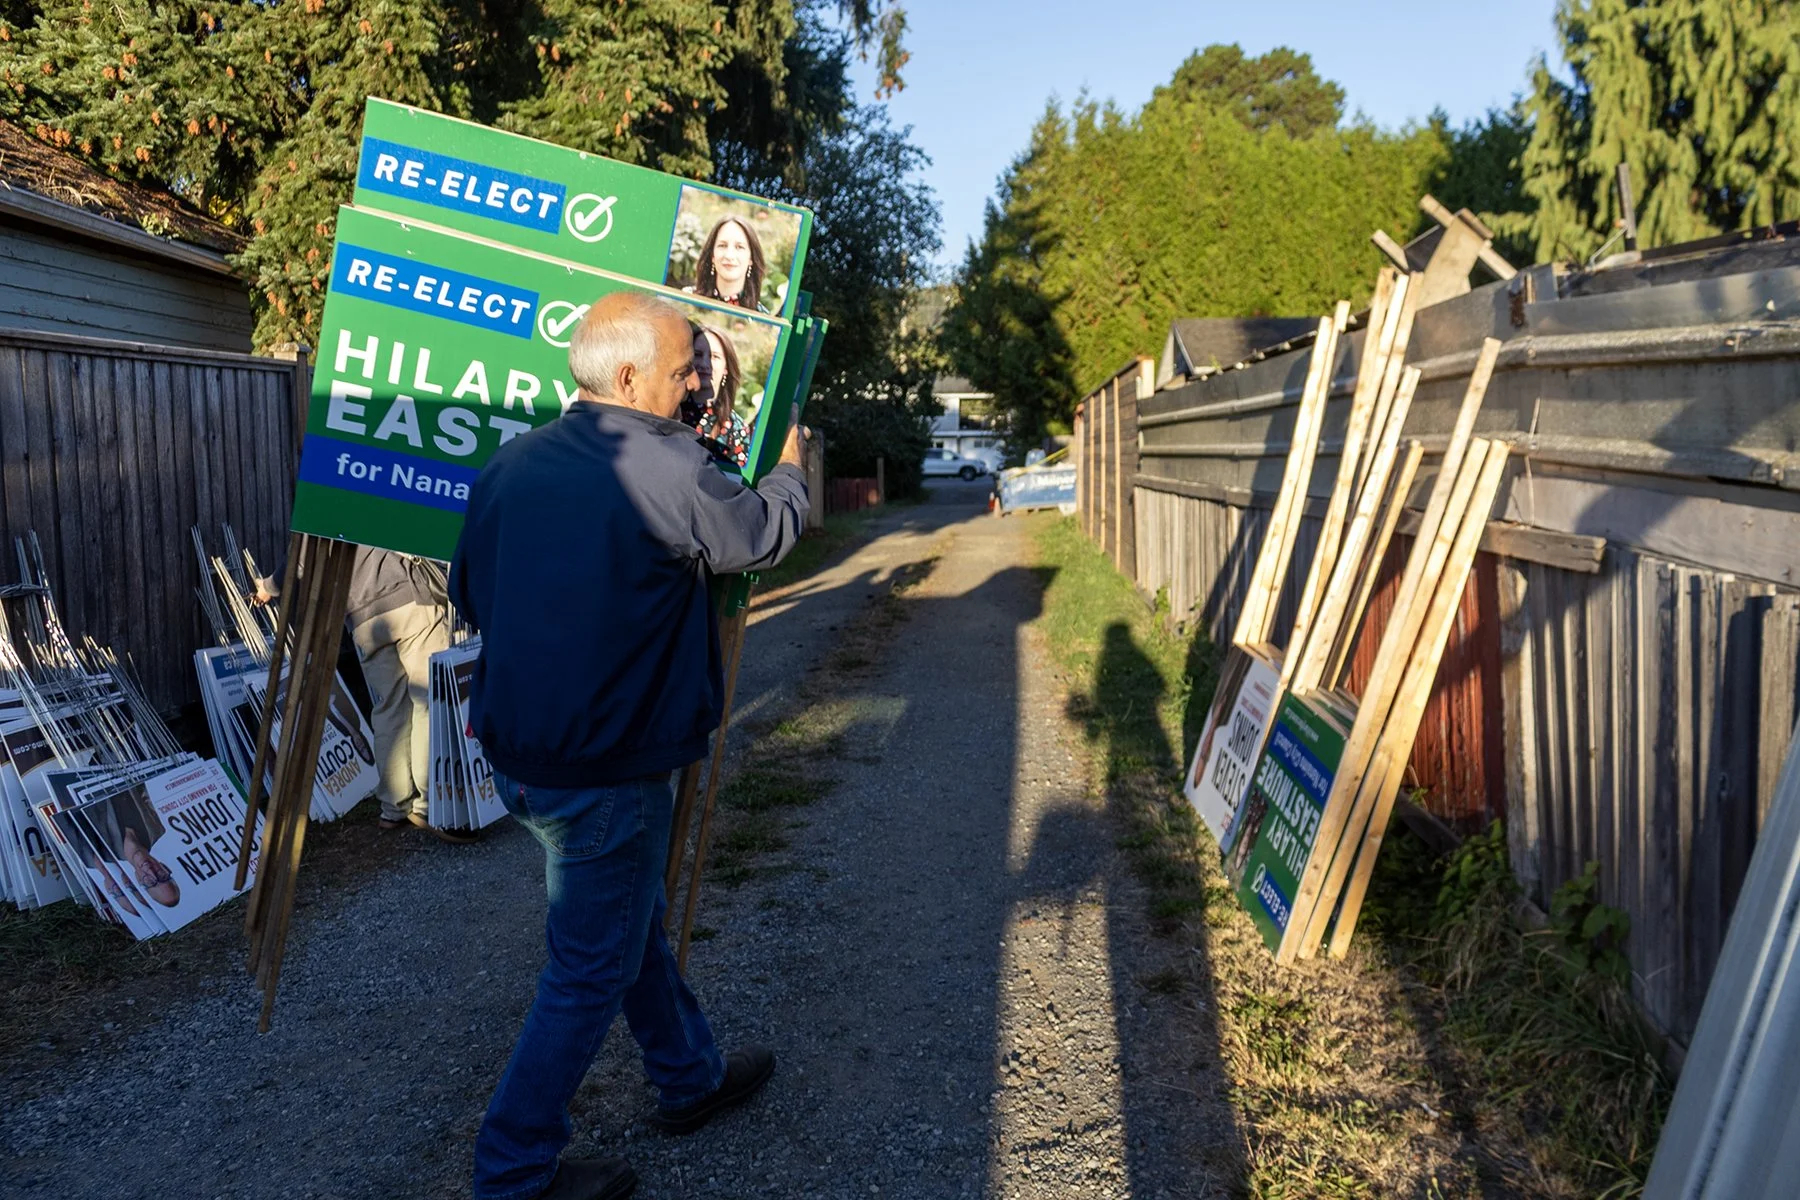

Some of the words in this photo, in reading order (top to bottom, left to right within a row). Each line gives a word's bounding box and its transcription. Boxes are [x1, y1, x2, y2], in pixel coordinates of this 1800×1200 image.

[373, 152, 558, 219] RE-ELECT
[346, 258, 531, 325] RE-ELECT
[333, 328, 580, 417] HILARY
[336, 453, 383, 482] for
[390, 463, 470, 501] Nana
[1228, 710, 1260, 768] JOHNS
[167, 792, 235, 845] JOHNS
[1256, 754, 1321, 849] EASTMURE
[1266, 814, 1308, 882] HILARY
